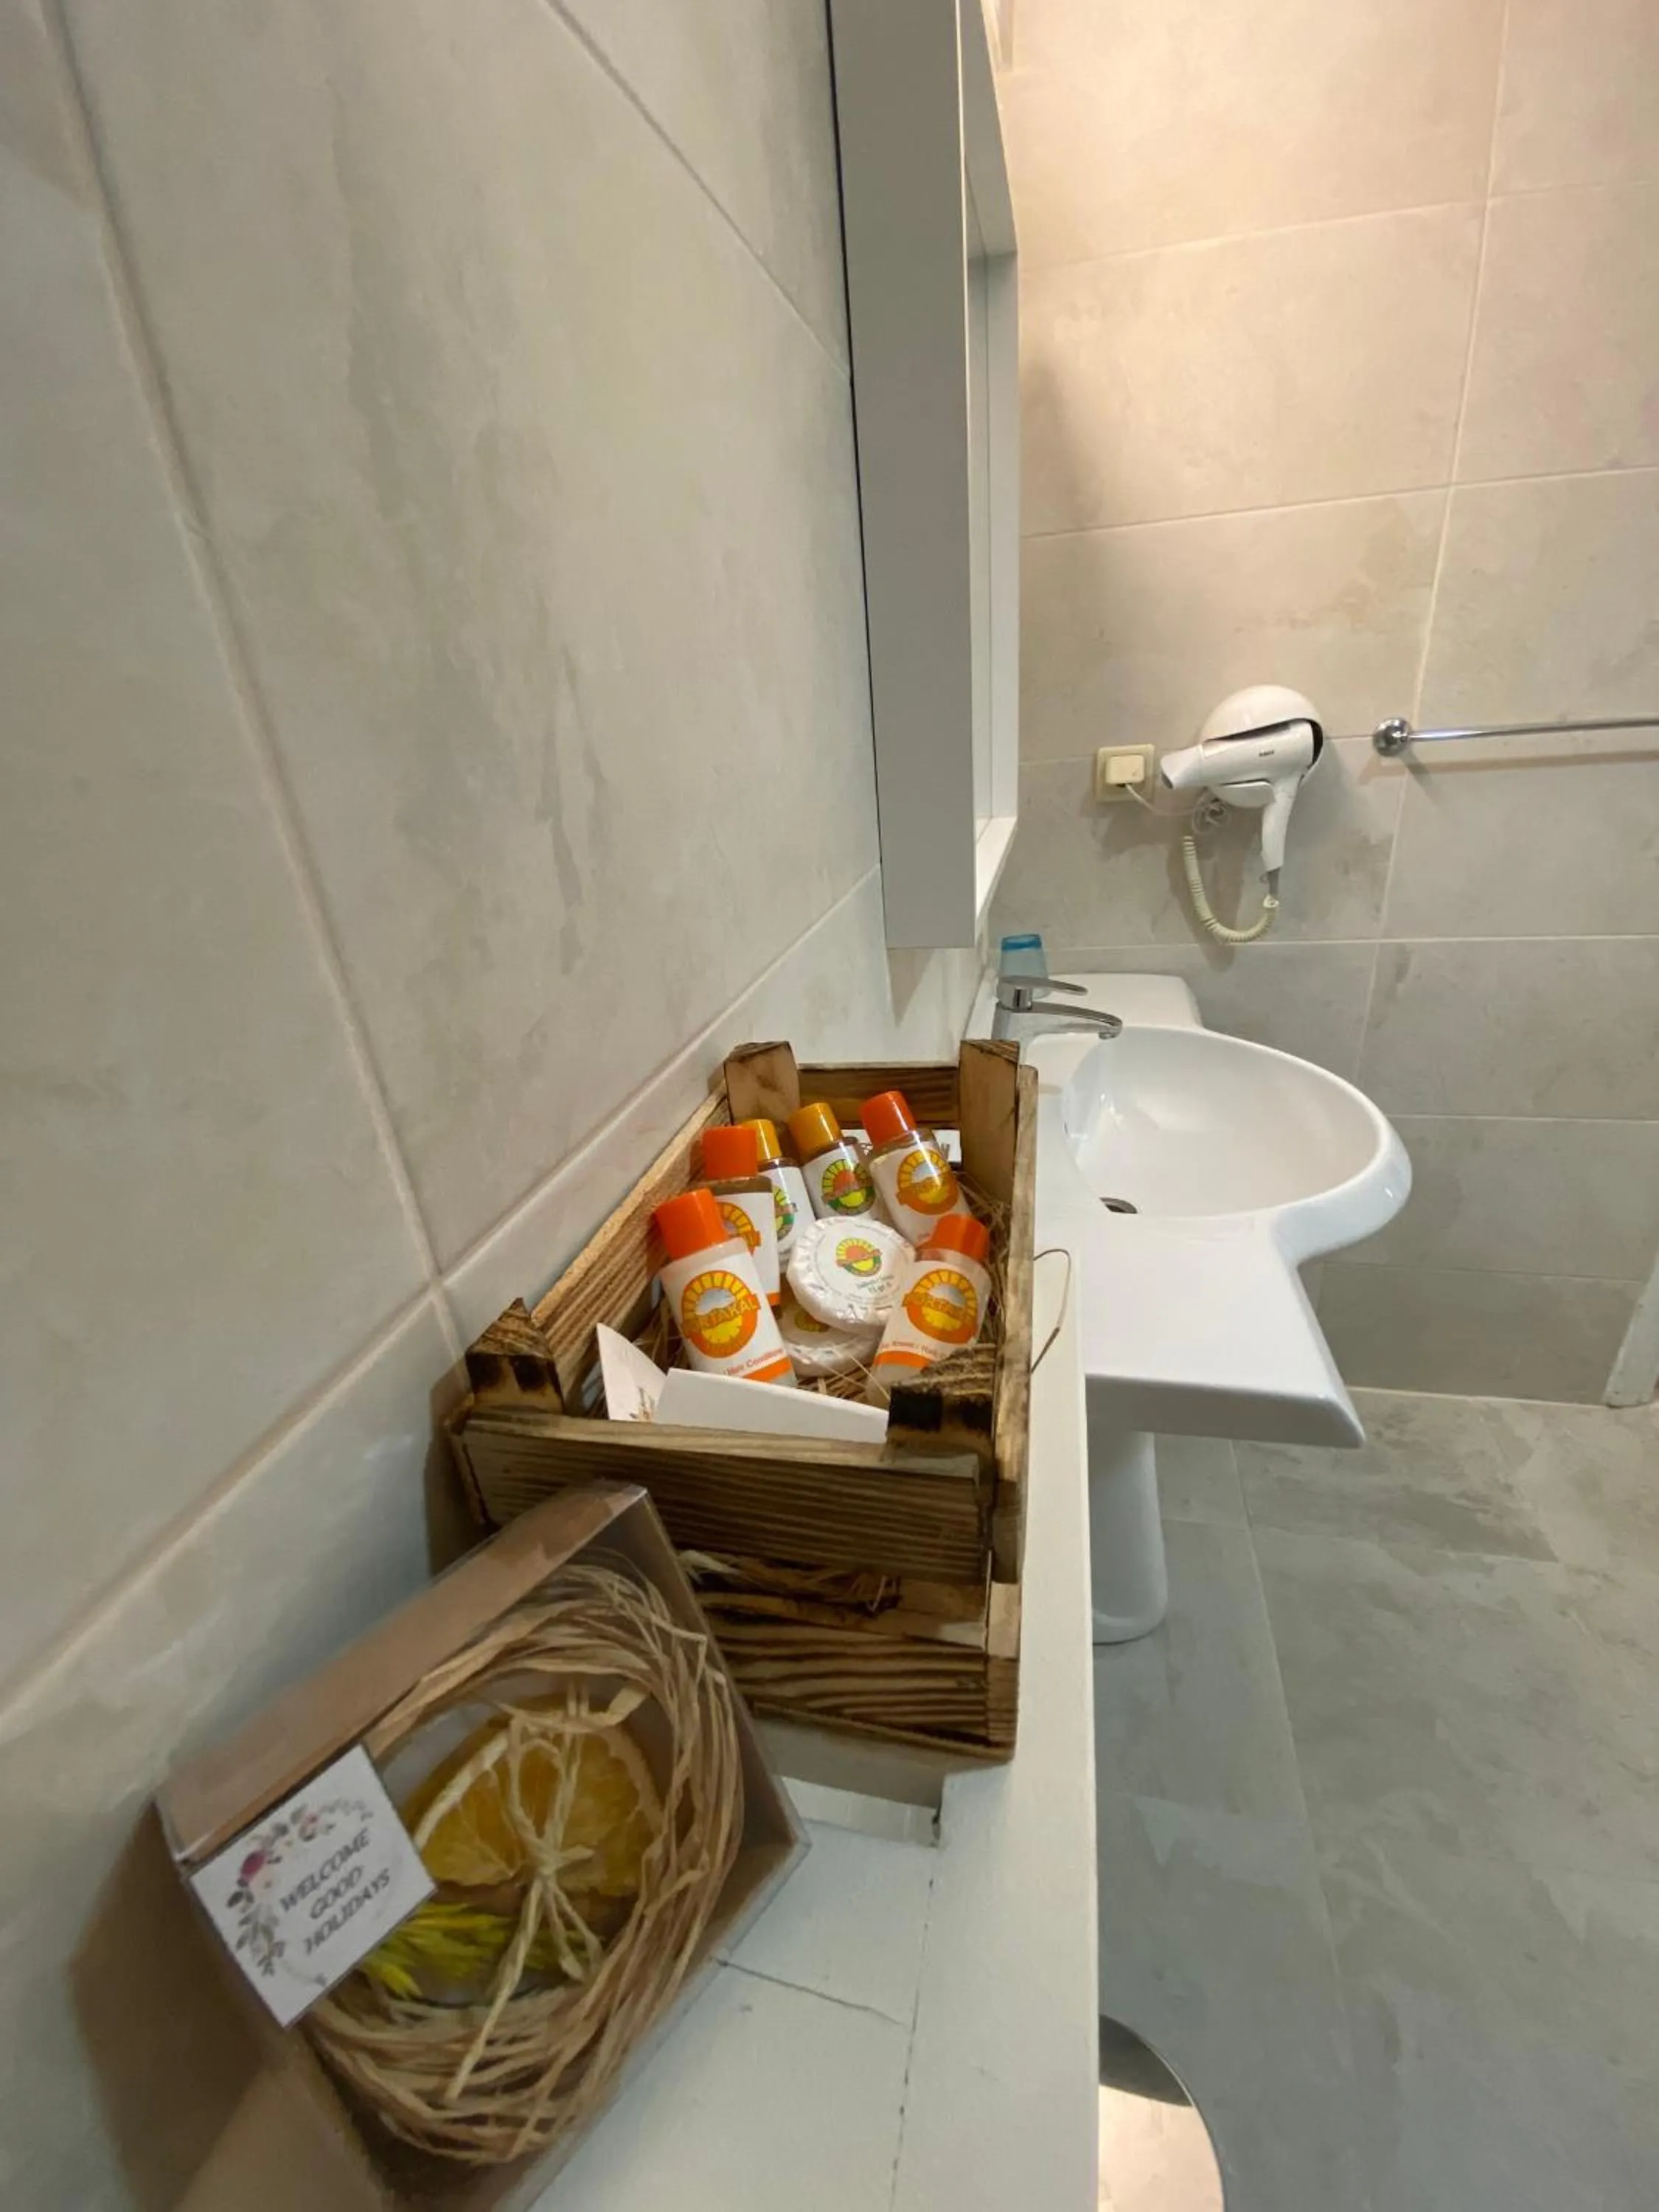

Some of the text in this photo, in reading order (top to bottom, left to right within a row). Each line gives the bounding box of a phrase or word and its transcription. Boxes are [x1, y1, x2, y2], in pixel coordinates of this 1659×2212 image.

[279, 1828, 371, 1913] WELCOME
[302, 1868, 391, 1955] HOLIDAYS
[310, 1865, 364, 1919] GOOD
